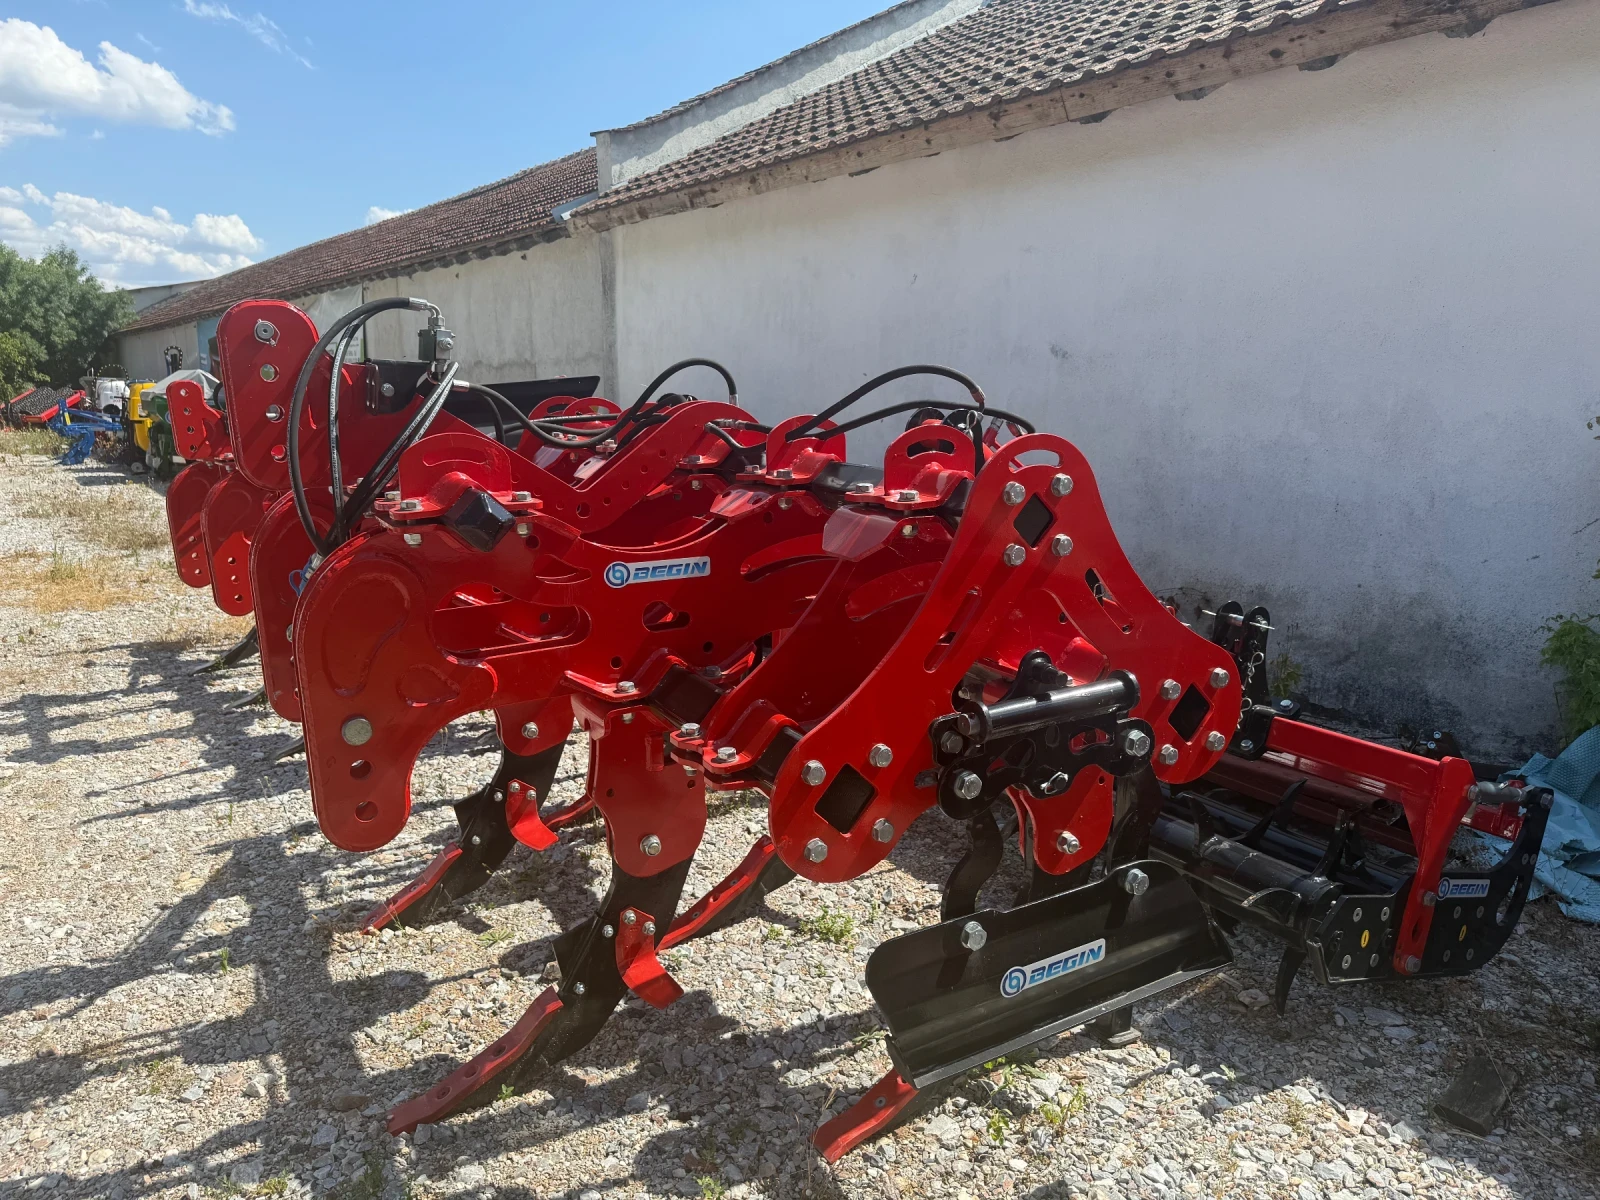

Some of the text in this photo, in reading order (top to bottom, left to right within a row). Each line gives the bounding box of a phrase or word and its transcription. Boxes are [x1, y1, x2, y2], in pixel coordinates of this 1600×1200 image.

[632, 561, 708, 581] BEGIN
[1449, 883, 1489, 895] BEGIN
[1028, 944, 1103, 985] BEGIN
